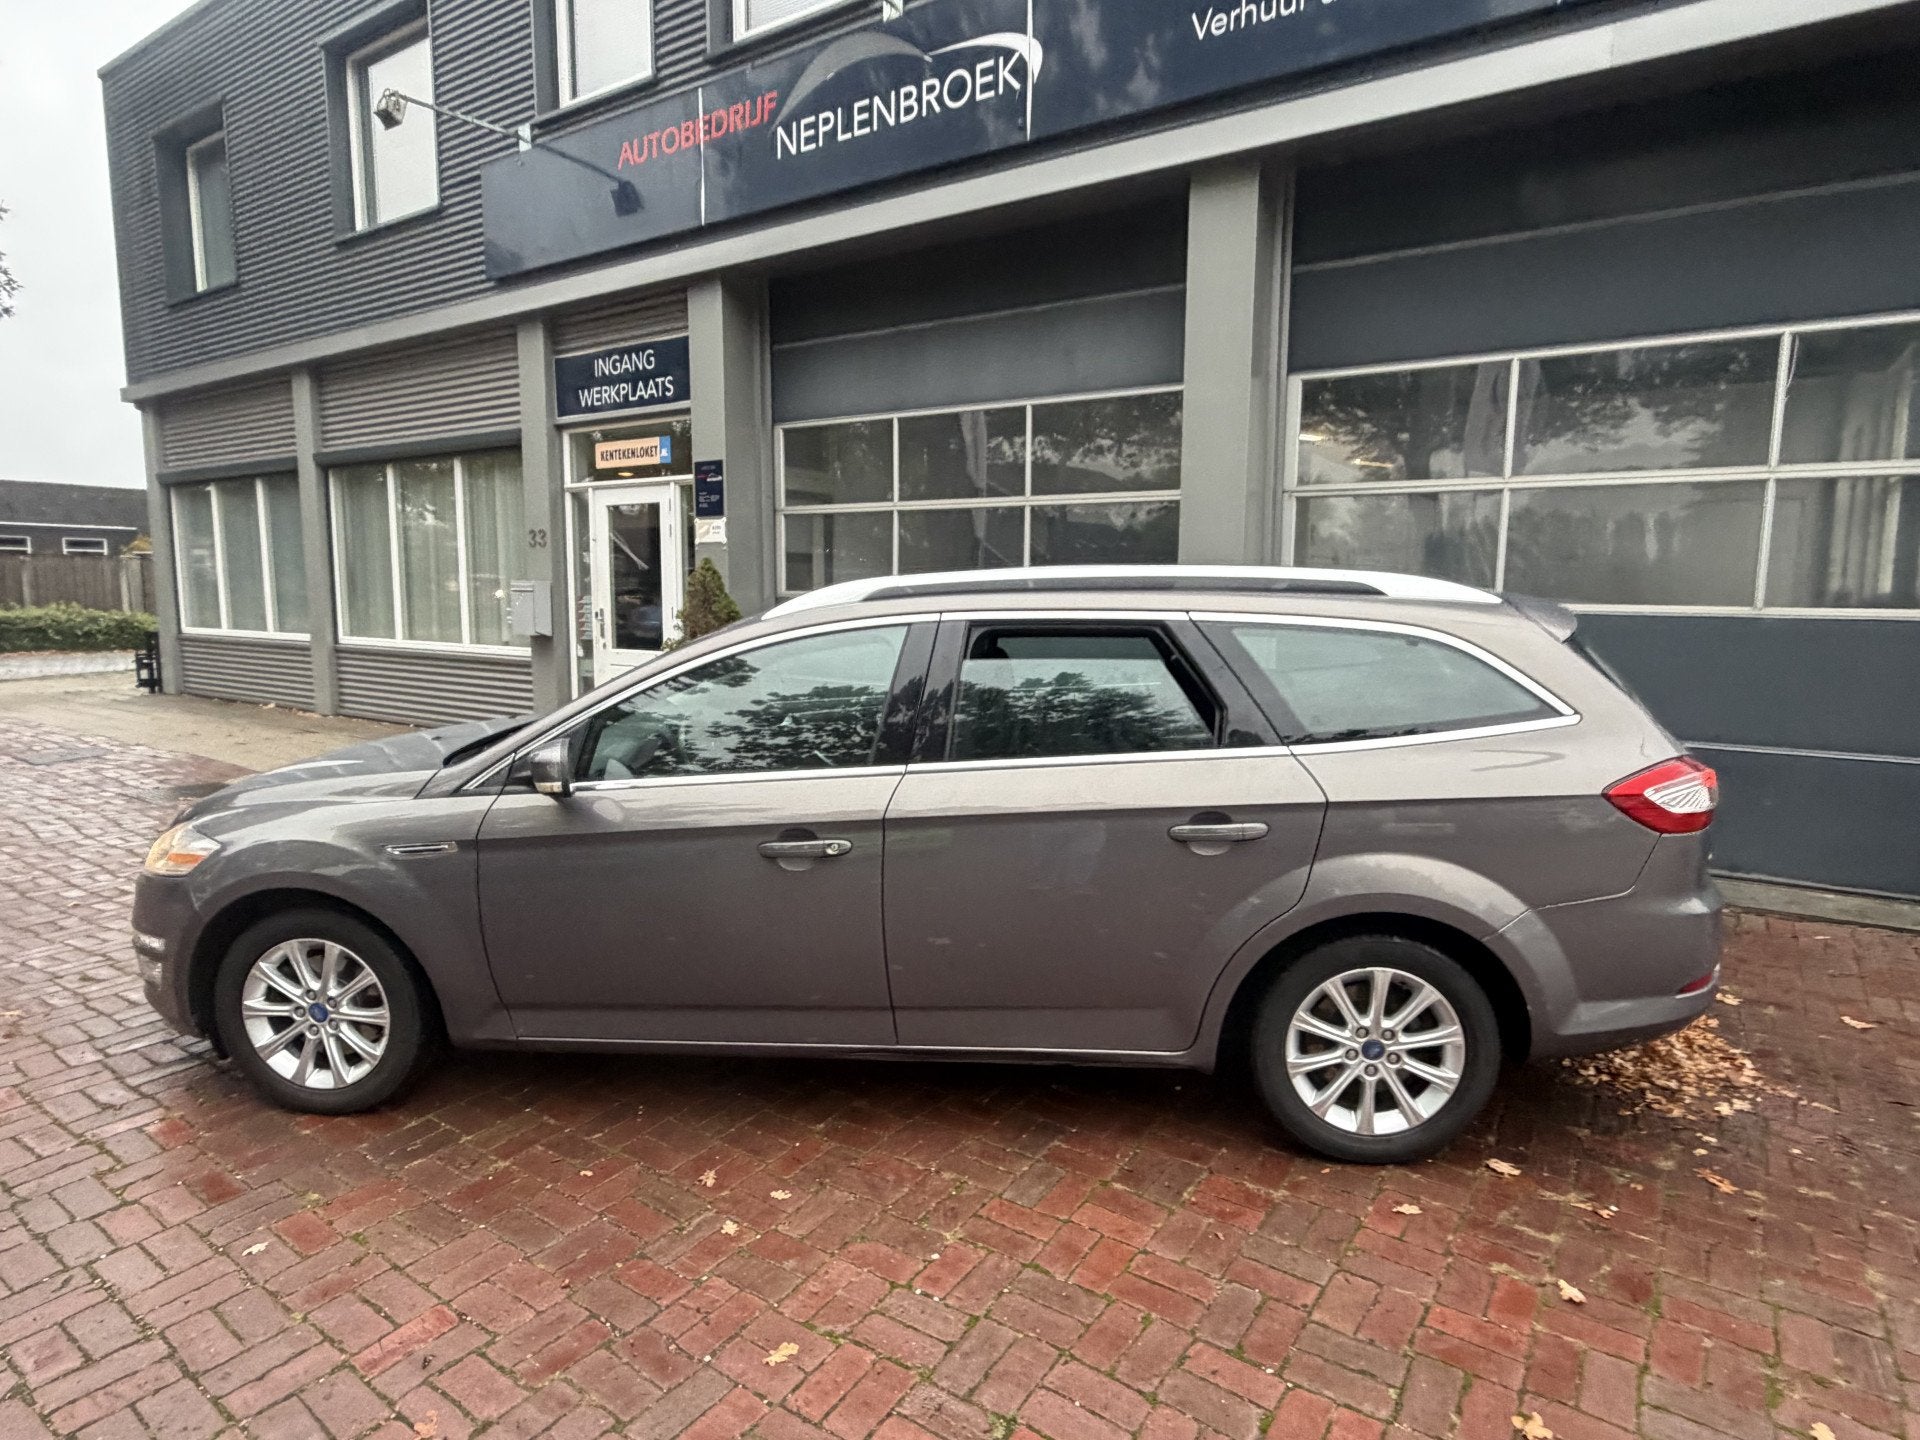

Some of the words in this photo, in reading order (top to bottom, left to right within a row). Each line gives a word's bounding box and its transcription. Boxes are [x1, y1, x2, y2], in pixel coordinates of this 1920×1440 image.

[776, 50, 1021, 161] NEPLENBROEK
[616, 90, 779, 170] AUTOBEDRIJF
[594, 348, 656, 377] INGANG
[578, 375, 674, 408] WERKPLAATS
[600, 445, 658, 462] KENTEKENLOKET
[528, 528, 548, 549] 33
